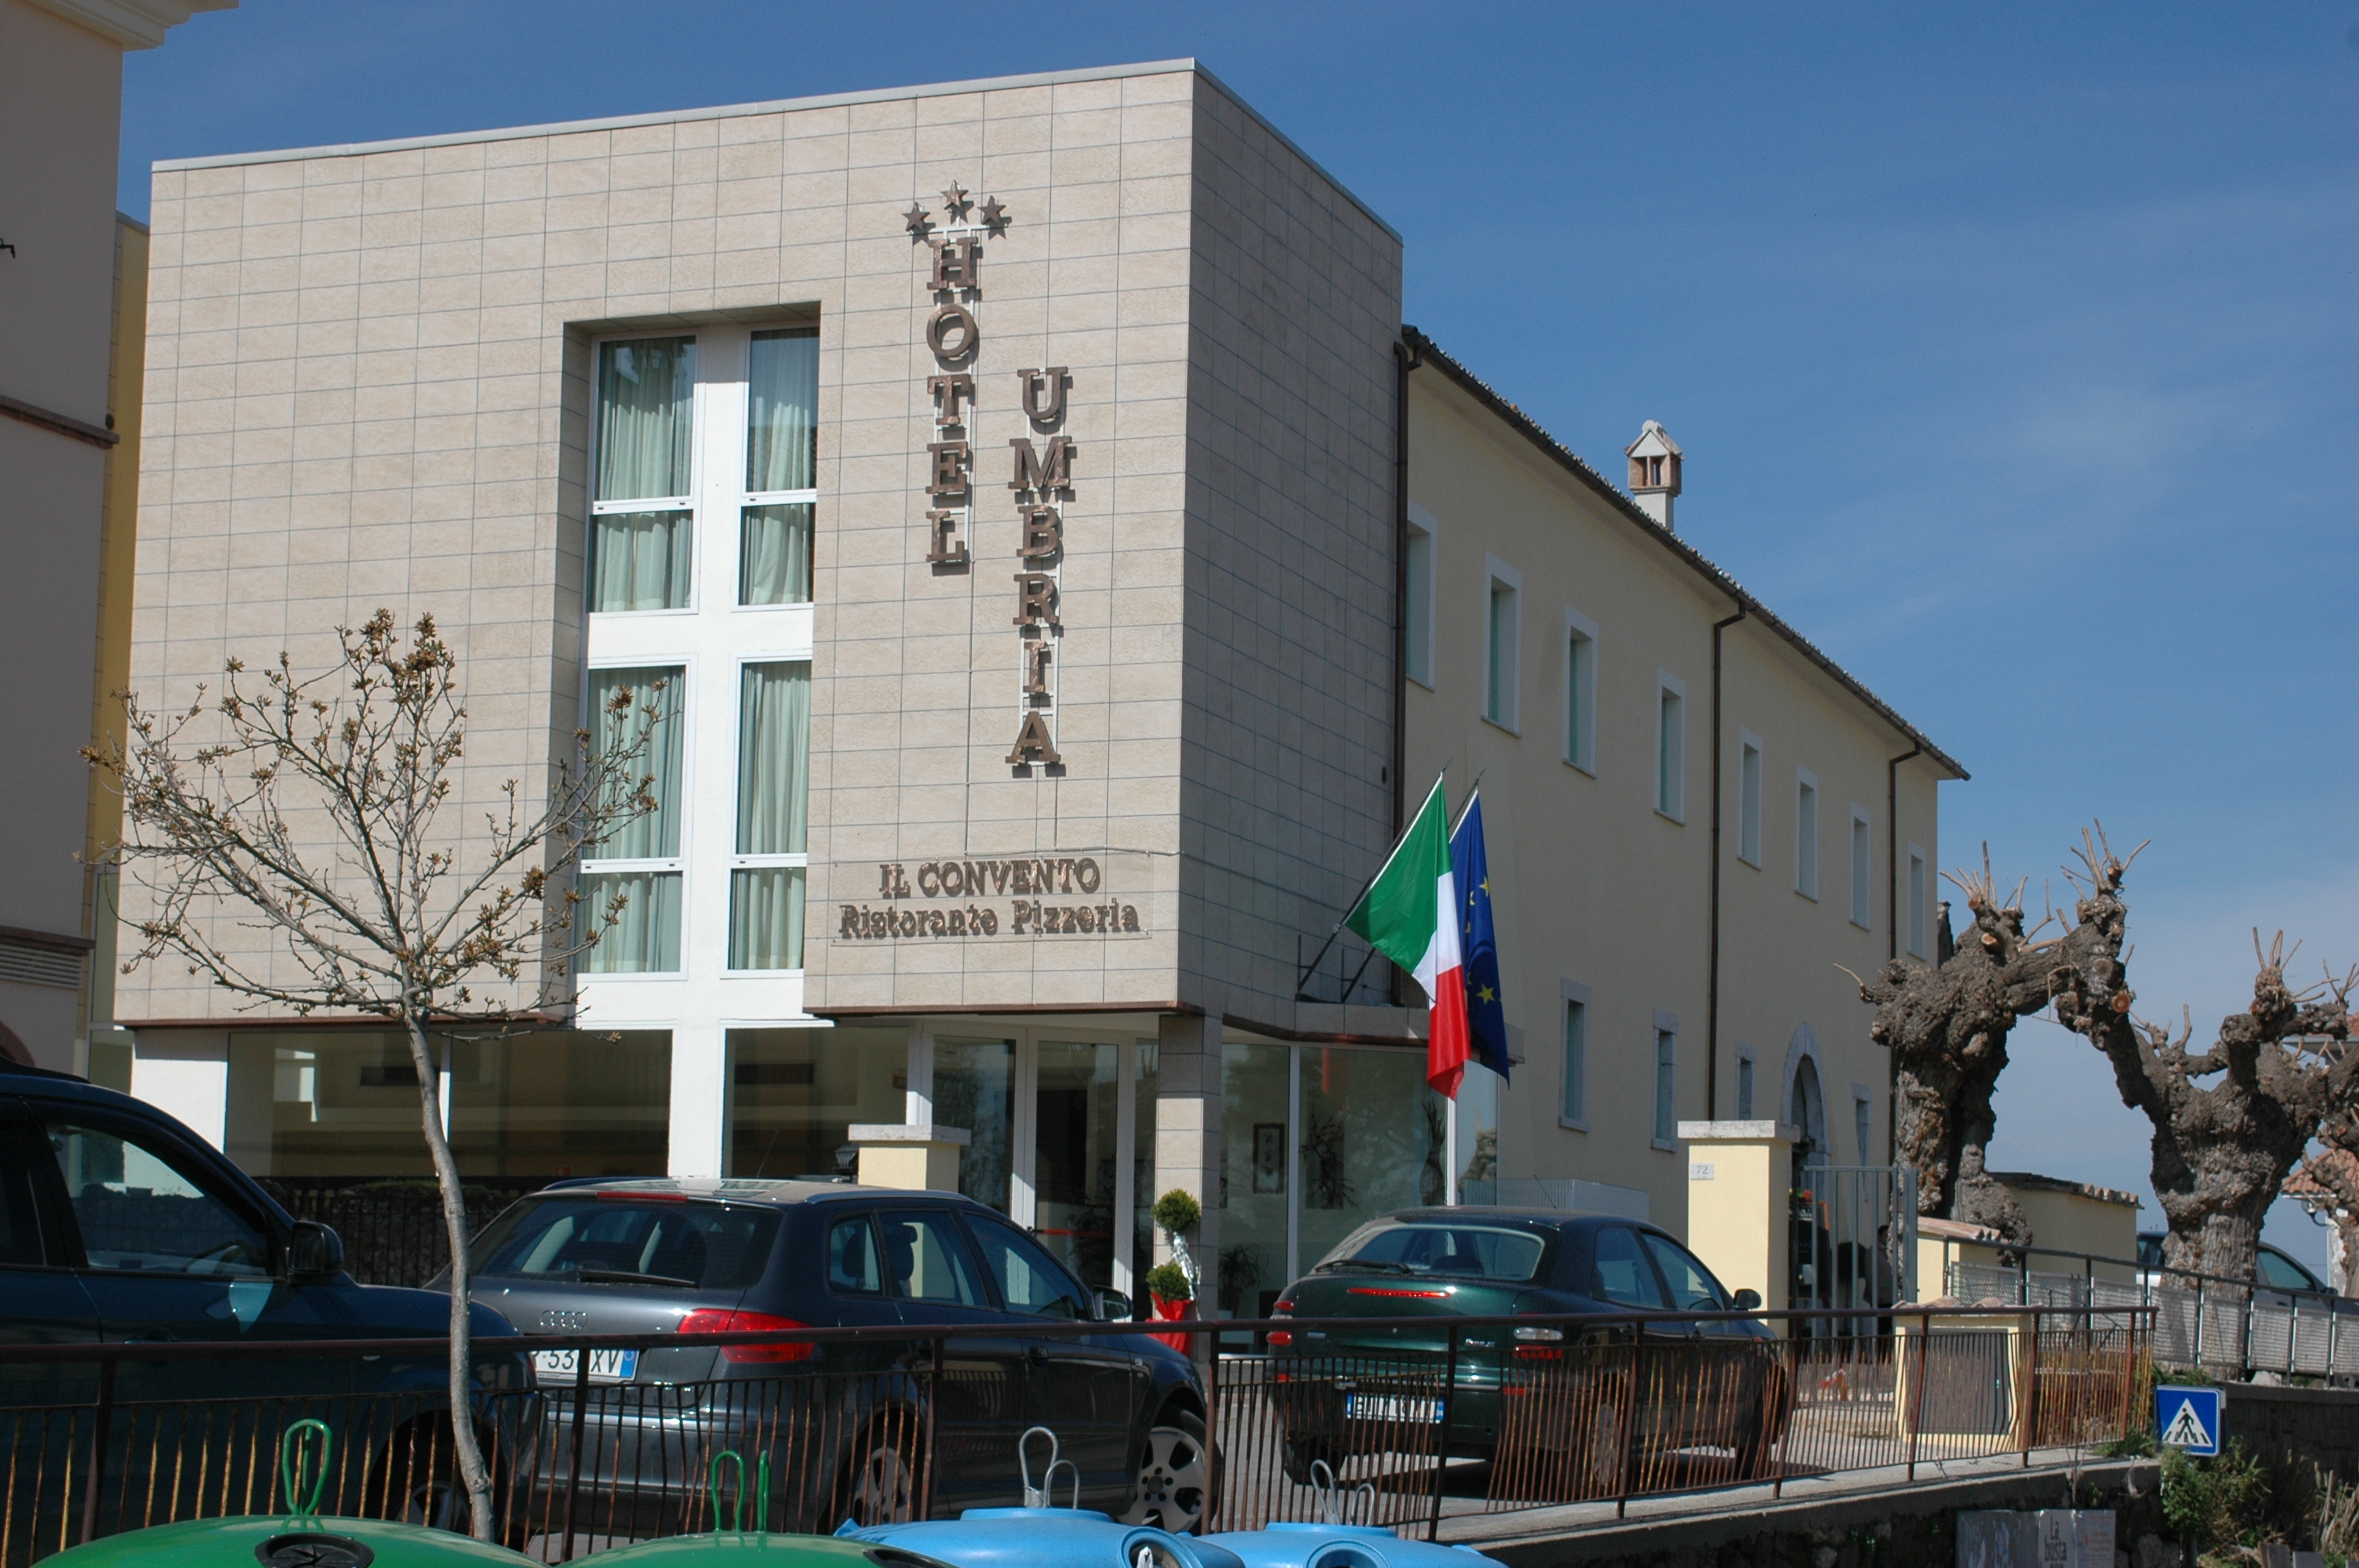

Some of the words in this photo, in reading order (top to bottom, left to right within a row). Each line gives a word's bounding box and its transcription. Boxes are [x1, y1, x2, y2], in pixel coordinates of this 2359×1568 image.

[925, 236, 979, 563] HOTEL
[1005, 365, 1072, 764] UMBRIA
[879, 862, 910, 896] IL
[918, 857, 1100, 896] CONVENTO
[838, 903, 998, 938] Ristorante
[1011, 897, 1140, 934] Pizzeria
[1696, 1164, 1709, 1174] 72
[2049, 1515, 2059, 1540] La
[2044, 1534, 2067, 1562] busta
